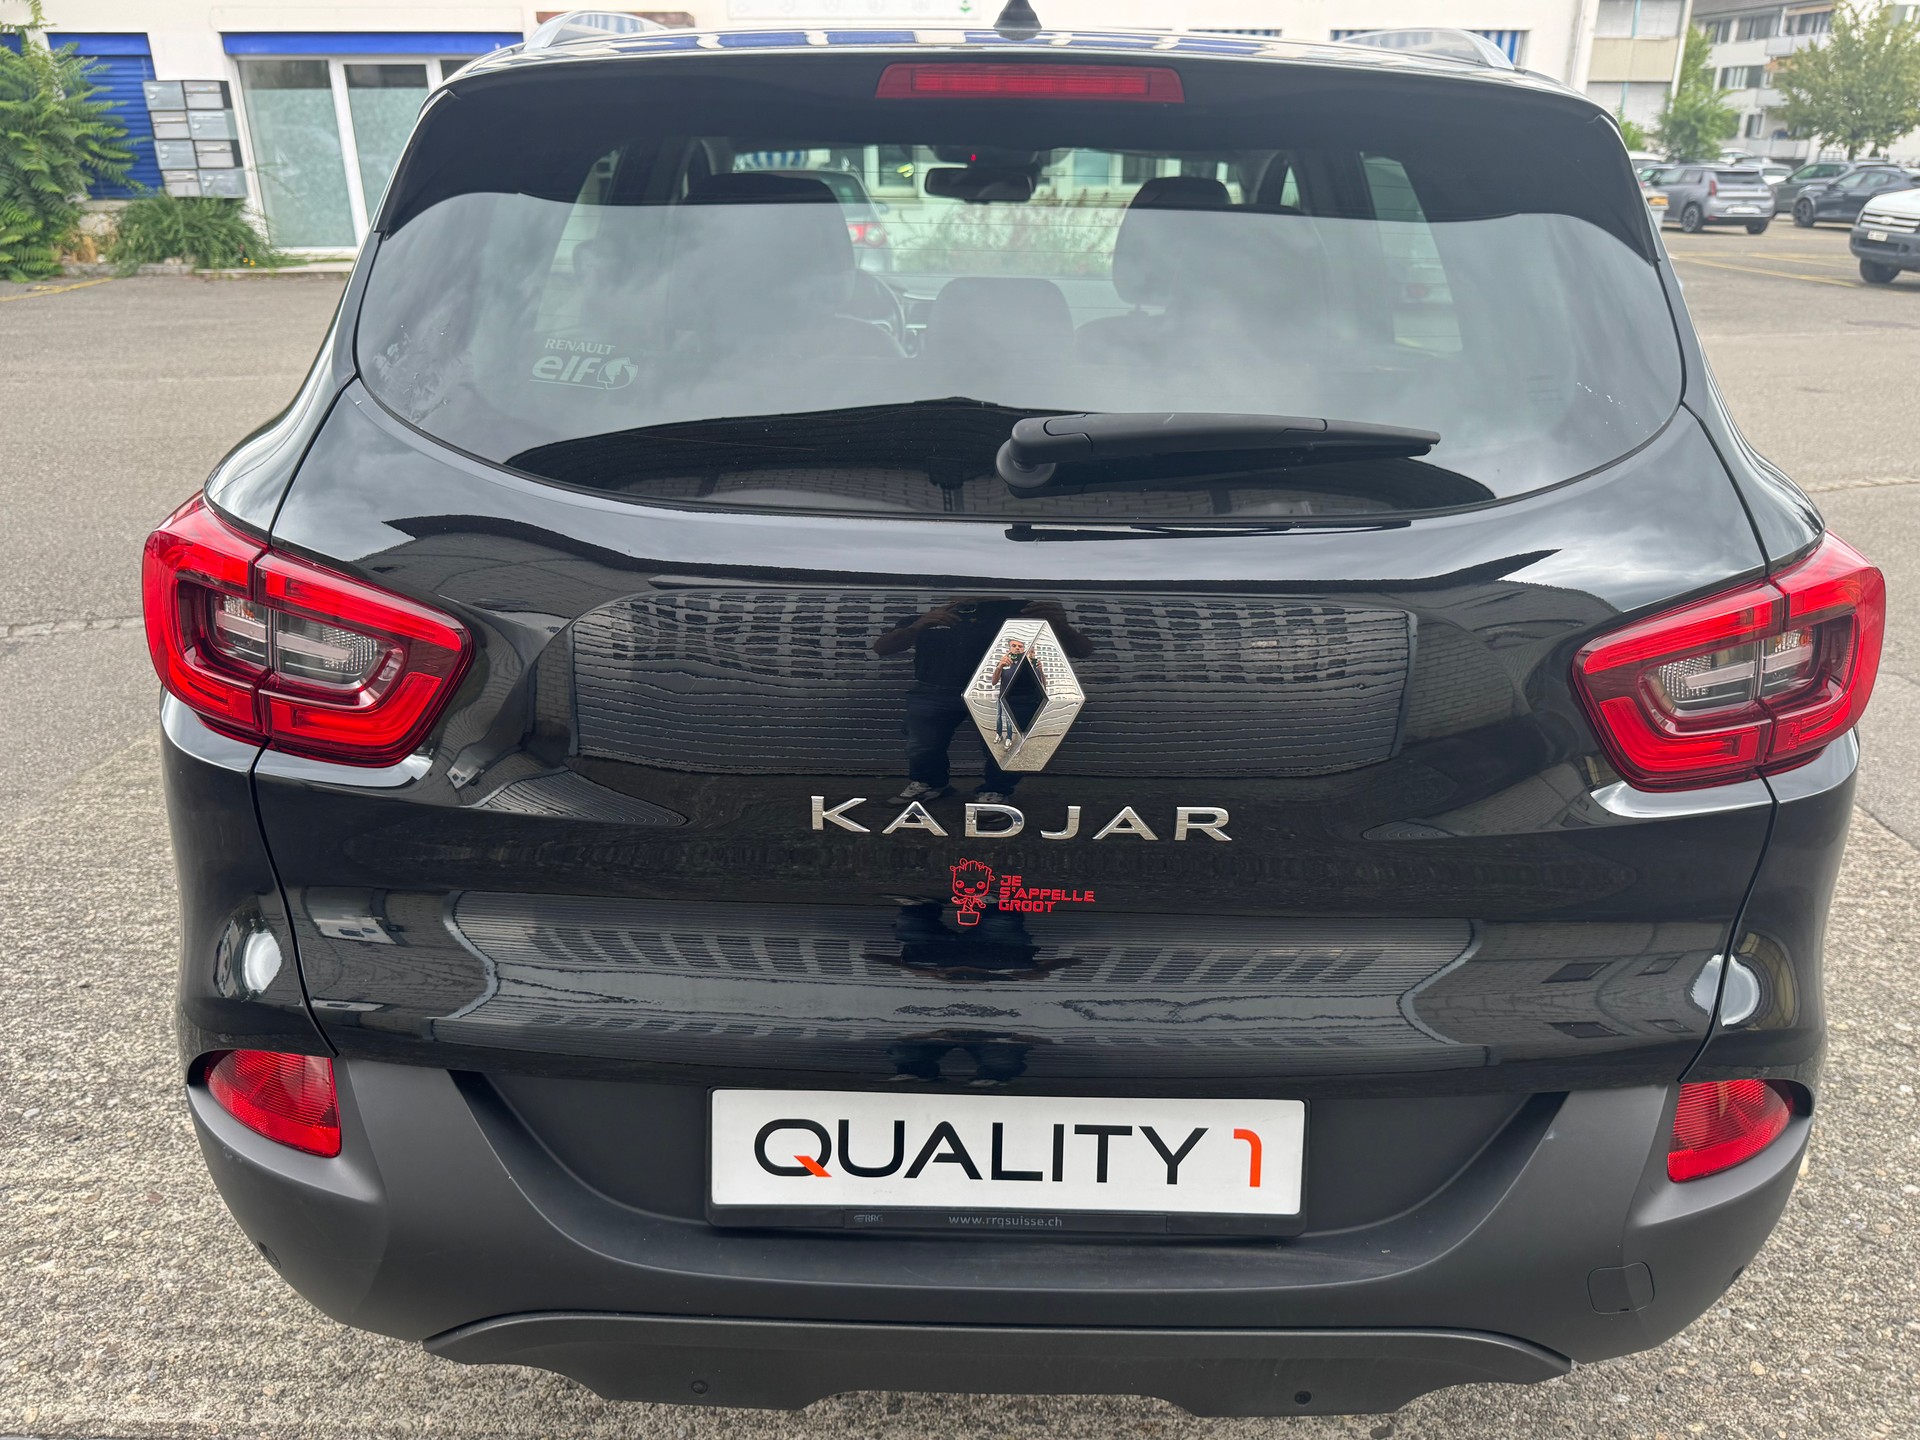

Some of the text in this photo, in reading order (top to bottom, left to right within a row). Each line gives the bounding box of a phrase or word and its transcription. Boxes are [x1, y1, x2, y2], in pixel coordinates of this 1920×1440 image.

[545, 338, 616, 355] RENAULT
[532, 355, 602, 383] elf
[810, 795, 1232, 842] KADJAR
[1000, 875, 1022, 887] JE
[999, 887, 1096, 903] S'APPELLE
[998, 899, 1056, 913] GROOT
[753, 1117, 1209, 1185] QUALITY
[948, 1215, 1063, 1227] www.rrgsuisse.ch
